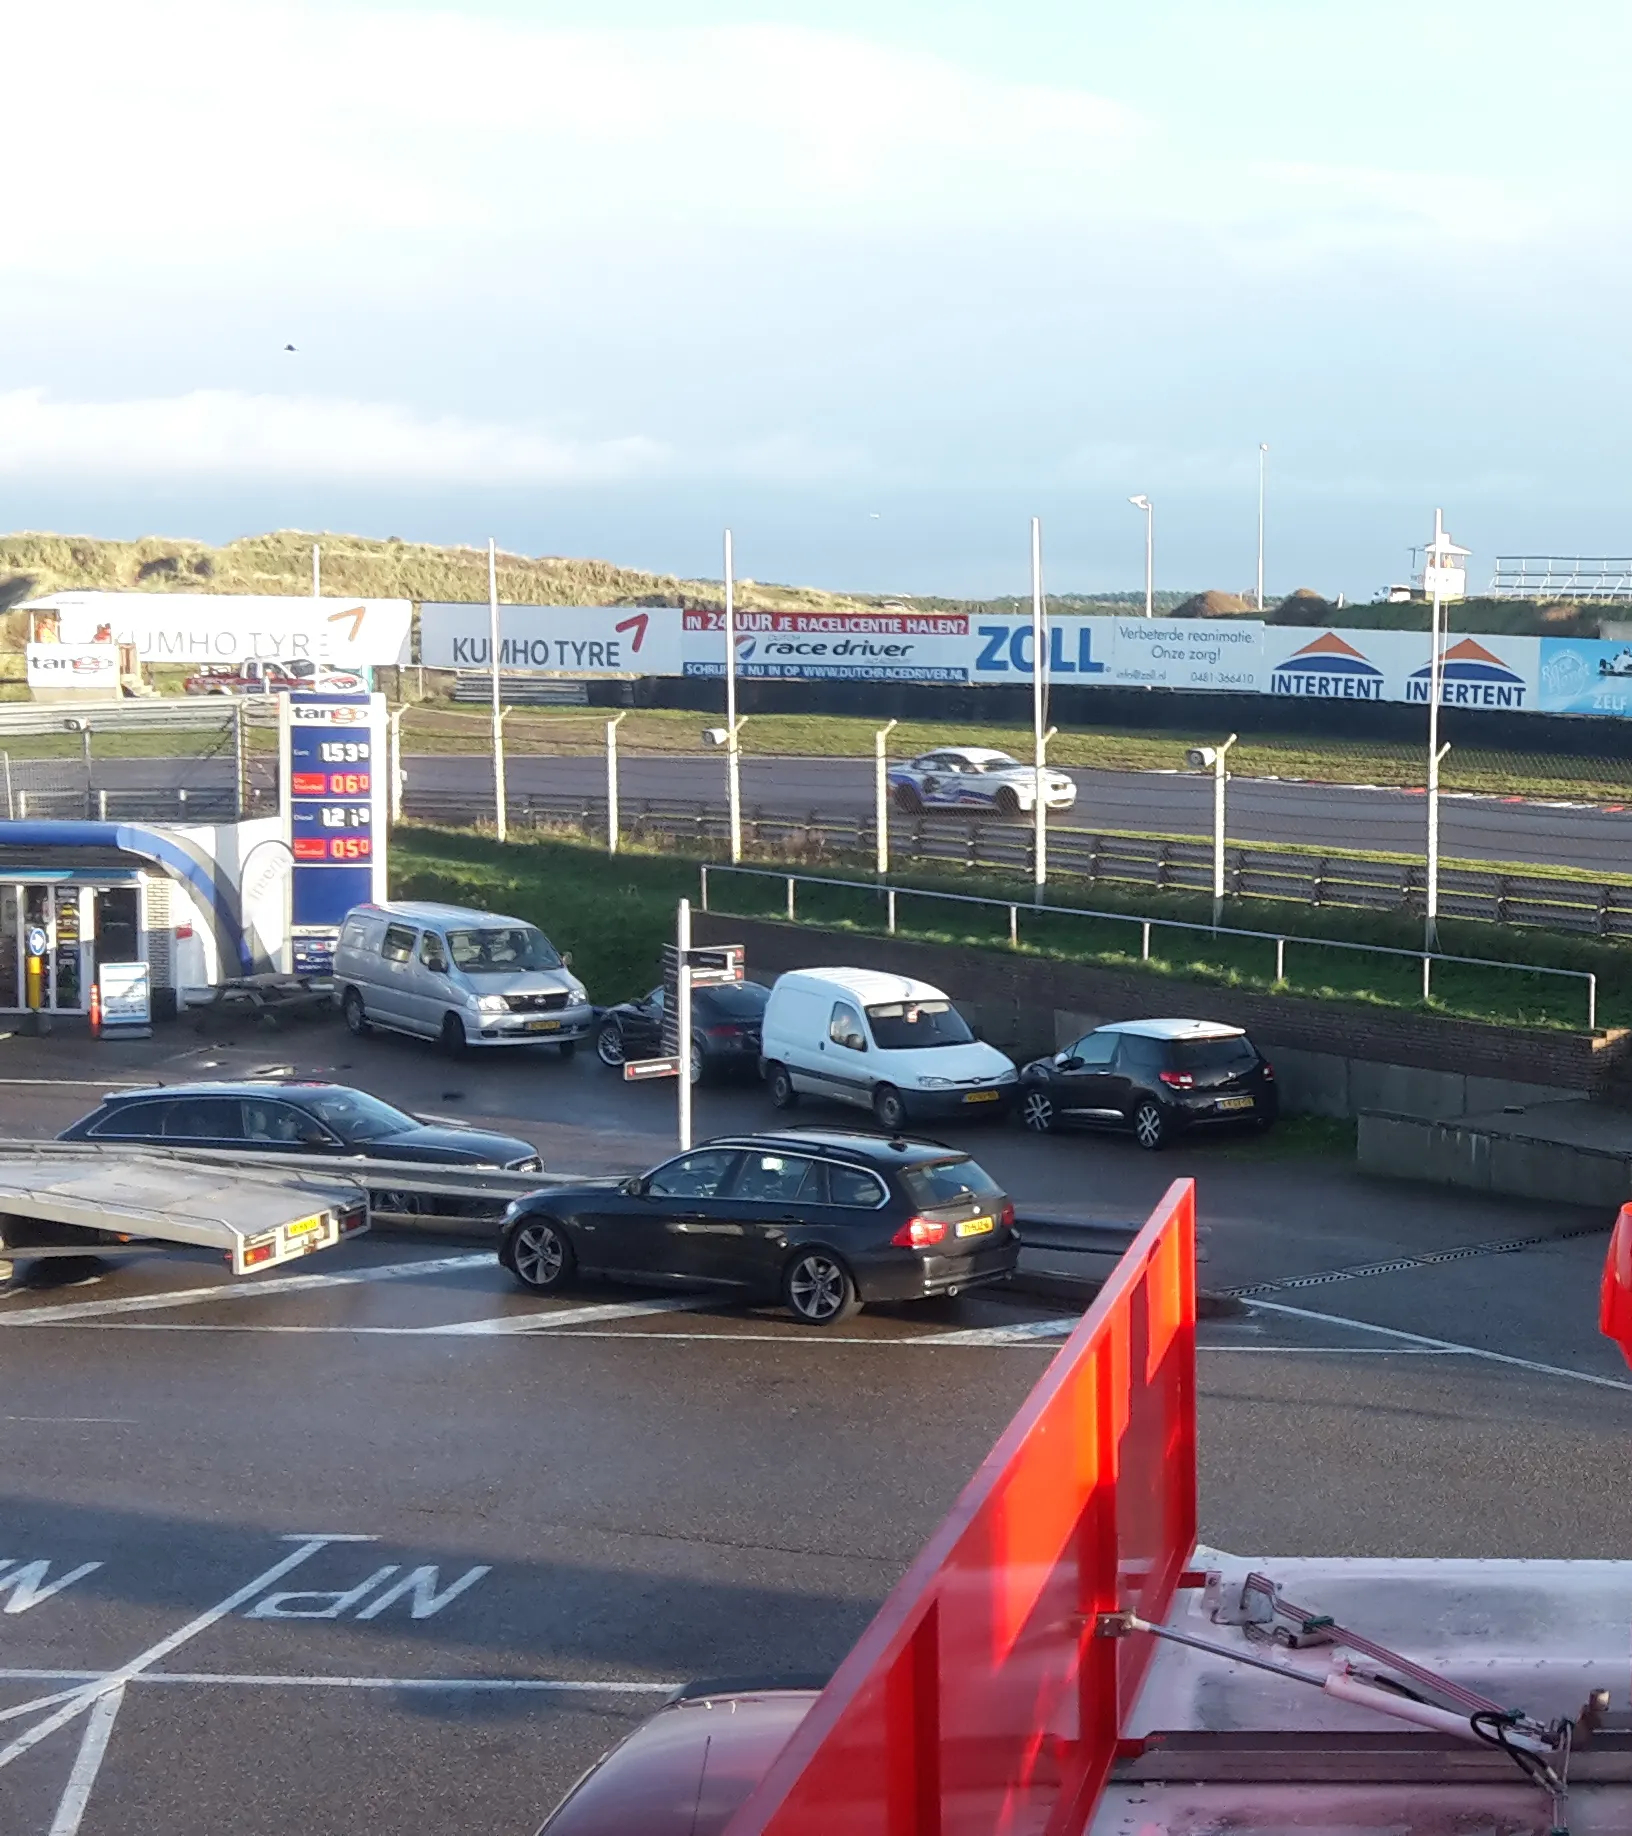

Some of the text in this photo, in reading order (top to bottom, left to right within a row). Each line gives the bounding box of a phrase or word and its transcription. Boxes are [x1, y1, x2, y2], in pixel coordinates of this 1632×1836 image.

[686, 615, 702, 630] IN
[735, 613, 773, 631] UUR
[777, 617, 793, 631] JE
[797, 617, 903, 633] RACELICENTIE
[907, 619, 966, 634] HALEN?
[1119, 625, 1255, 643] Verbeterde reanimatie.
[453, 637, 621, 667] KUMHO TYRE
[765, 639, 914, 657] race driver
[975, 625, 1105, 673] ZOLL
[1151, 645, 1185, 659] Onze
[748, 664, 764, 676] NU
[769, 665, 781, 676] IN
[784, 665, 800, 676] OP
[1271, 674, 1384, 699] INTERTENT
[1592, 695, 1627, 712] ZELF
